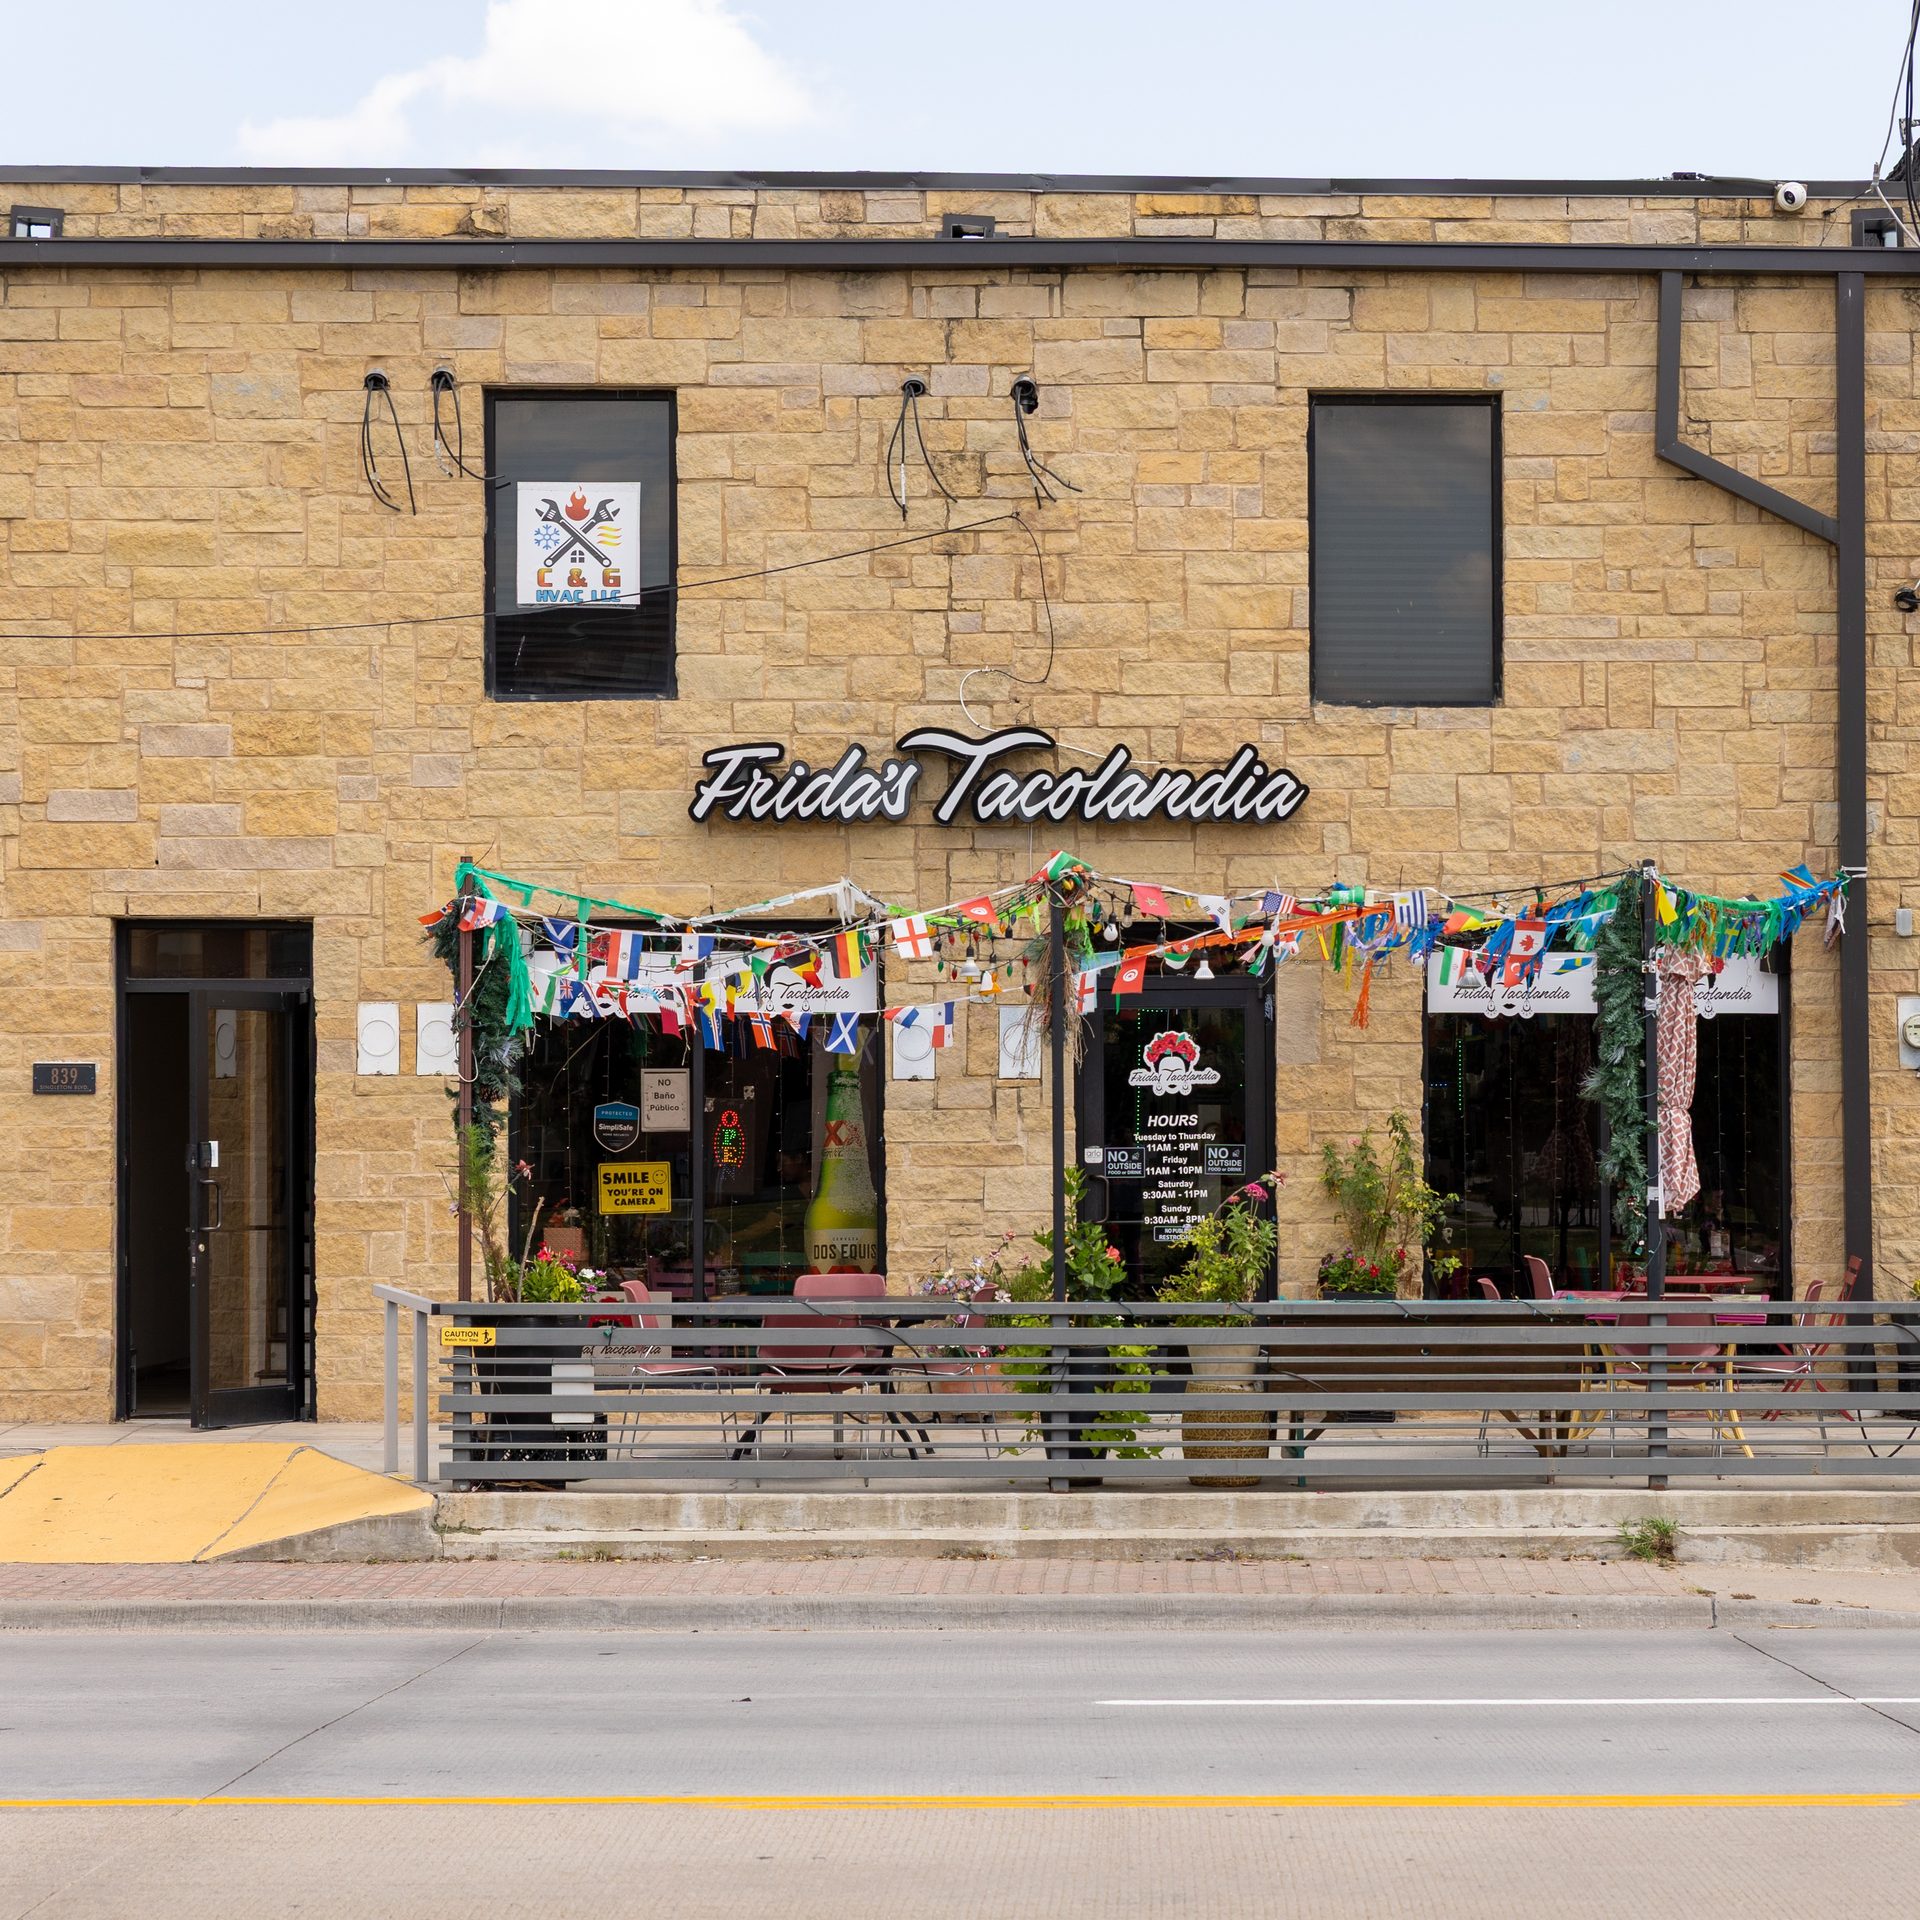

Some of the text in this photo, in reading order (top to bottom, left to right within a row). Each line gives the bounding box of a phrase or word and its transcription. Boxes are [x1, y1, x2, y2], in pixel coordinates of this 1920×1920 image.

[536, 568, 621, 587] C & G
[536, 590, 621, 602] HVAC LLC
[691, 729, 1306, 824] Frida's Tacolandia
[780, 986, 850, 999] Tacolandia
[1693, 987, 1753, 1000] colandia
[51, 1068, 78, 1085] 839
[1130, 1071, 1218, 1082] Fridas Tacolandia
[1147, 1115, 1199, 1127] HOURS
[1133, 1133, 1167, 1143] Tuesday
[1178, 1132, 1216, 1142] Thursday
[1146, 1144, 1171, 1152] 11AM
[1178, 1143, 1199, 1151] 9PM
[1107, 1151, 1128, 1162] NO
[1208, 1148, 1229, 1159] NO
[1107, 1162, 1142, 1170] OUTSIDE
[1162, 1156, 1188, 1165] Friday
[1207, 1159, 1242, 1167] OUTSIDE
[1145, 1167, 1170, 1175] 11AM
[1179, 1166, 1203, 1174] 10PM
[602, 1172, 649, 1184] SMILE
[1158, 1180, 1194, 1189] Saturday
[607, 1188, 644, 1196] YOU'RE
[1142, 1191, 1176, 1199] 9:30AM
[1184, 1190, 1208, 1198] 11PM
[614, 1198, 656, 1206] CAMERA
[1161, 1205, 1192, 1213] Sunday
[1144, 1215, 1178, 1224] 9:30AM
[1185, 1215, 1205, 1223] 8PM
[813, 1243, 877, 1260] DOS EQUIS
